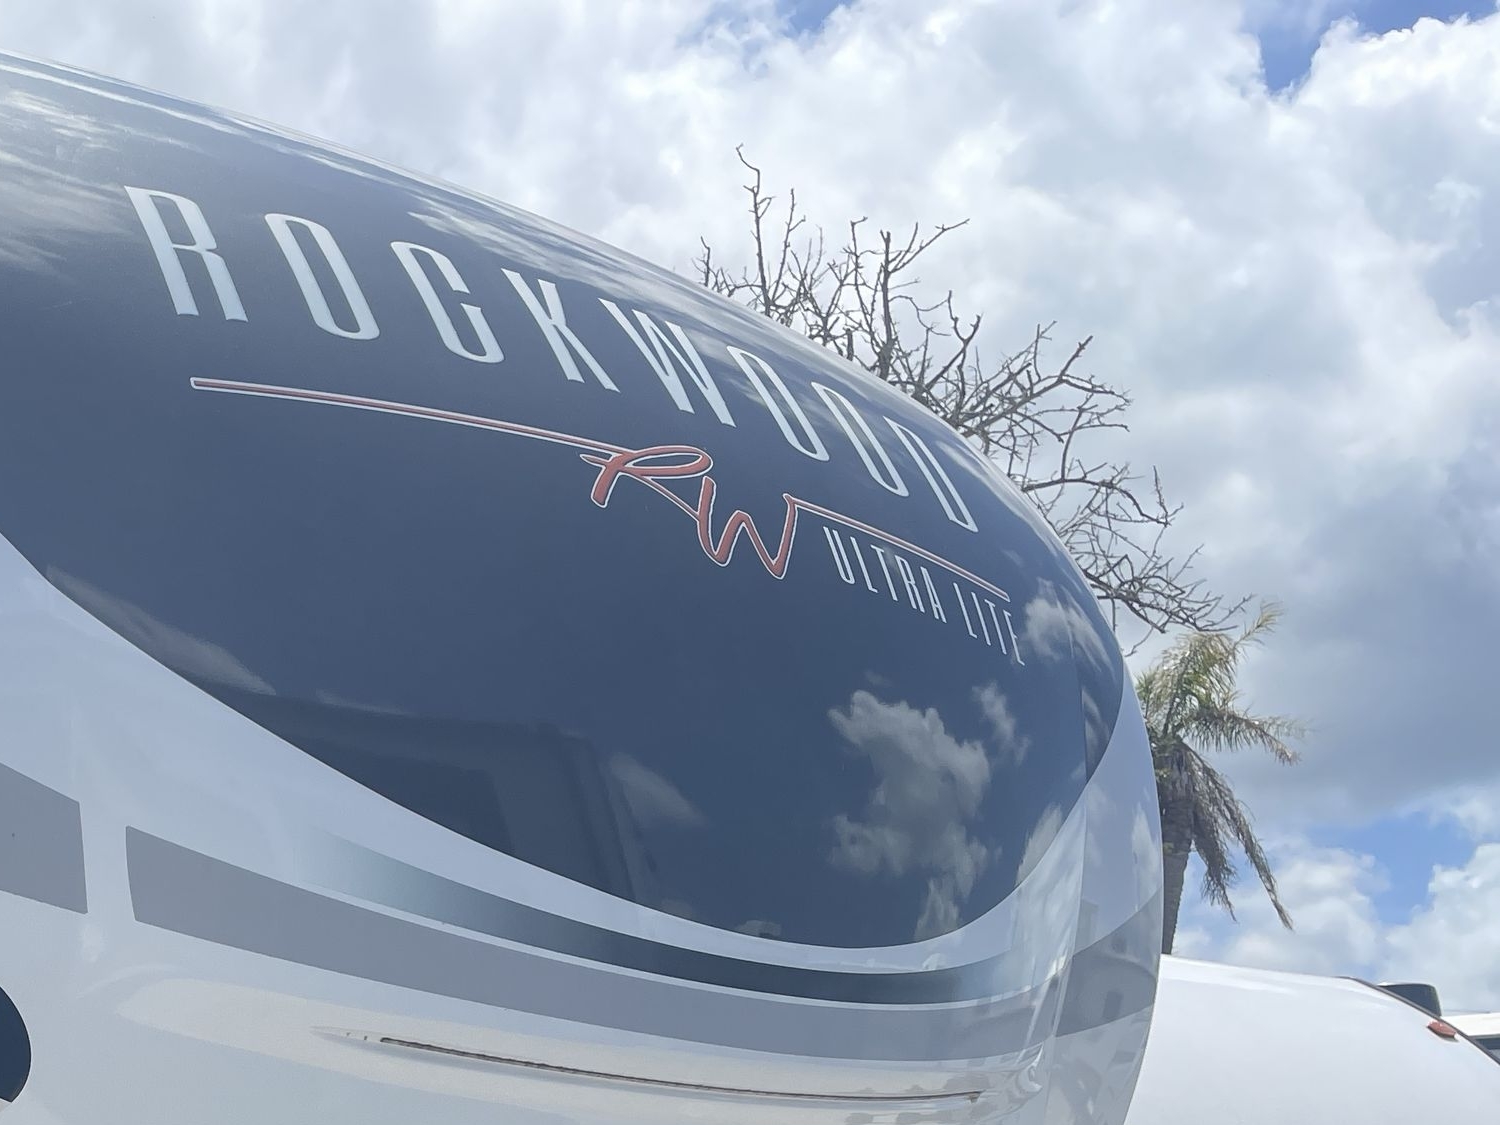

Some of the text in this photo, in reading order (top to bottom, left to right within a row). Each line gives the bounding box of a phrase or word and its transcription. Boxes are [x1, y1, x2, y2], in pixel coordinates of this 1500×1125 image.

[123, 185, 979, 533] ROCKWOOD
[822, 525, 1026, 666] ULTRA LITE
